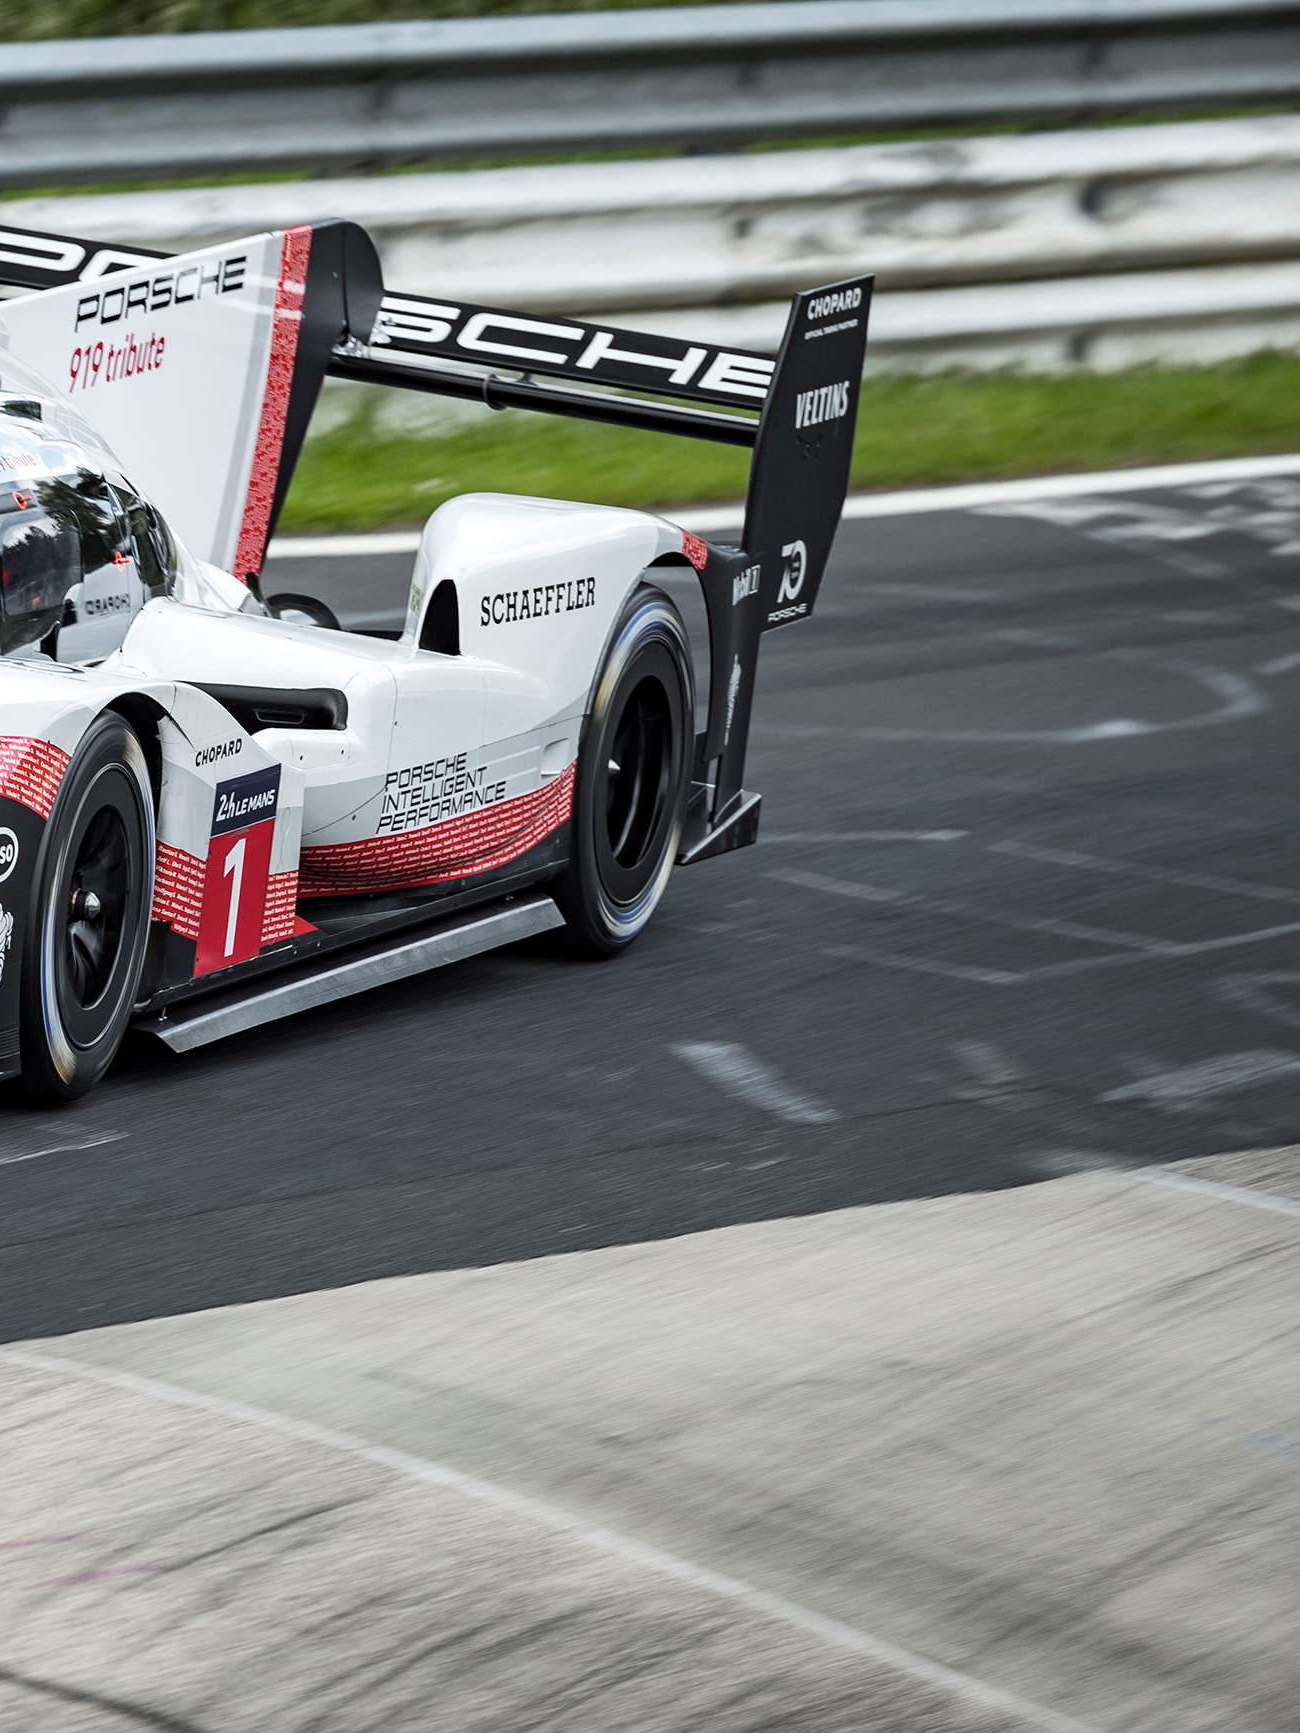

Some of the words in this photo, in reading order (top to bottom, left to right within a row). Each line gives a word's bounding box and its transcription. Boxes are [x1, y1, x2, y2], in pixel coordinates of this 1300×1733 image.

[74, 255, 247, 333] PORSCHE
[807, 287, 862, 320] CHOPARD
[69, 341, 104, 393] 919
[106, 332, 165, 382] tribute
[795, 381, 850, 429] VELTINS
[480, 577, 596, 627] SCHAEFFLER
[768, 603, 807, 623] PORSCHE
[195, 738, 242, 767] CHOPARD
[385, 752, 467, 792] PORSCHE
[234, 798, 249, 816] LE
[247, 789, 276, 812] MANS
[376, 781, 506, 834] PERFORMANCE
[382, 766, 487, 813] INTELLIGENT
[223, 838, 247, 958] 1
